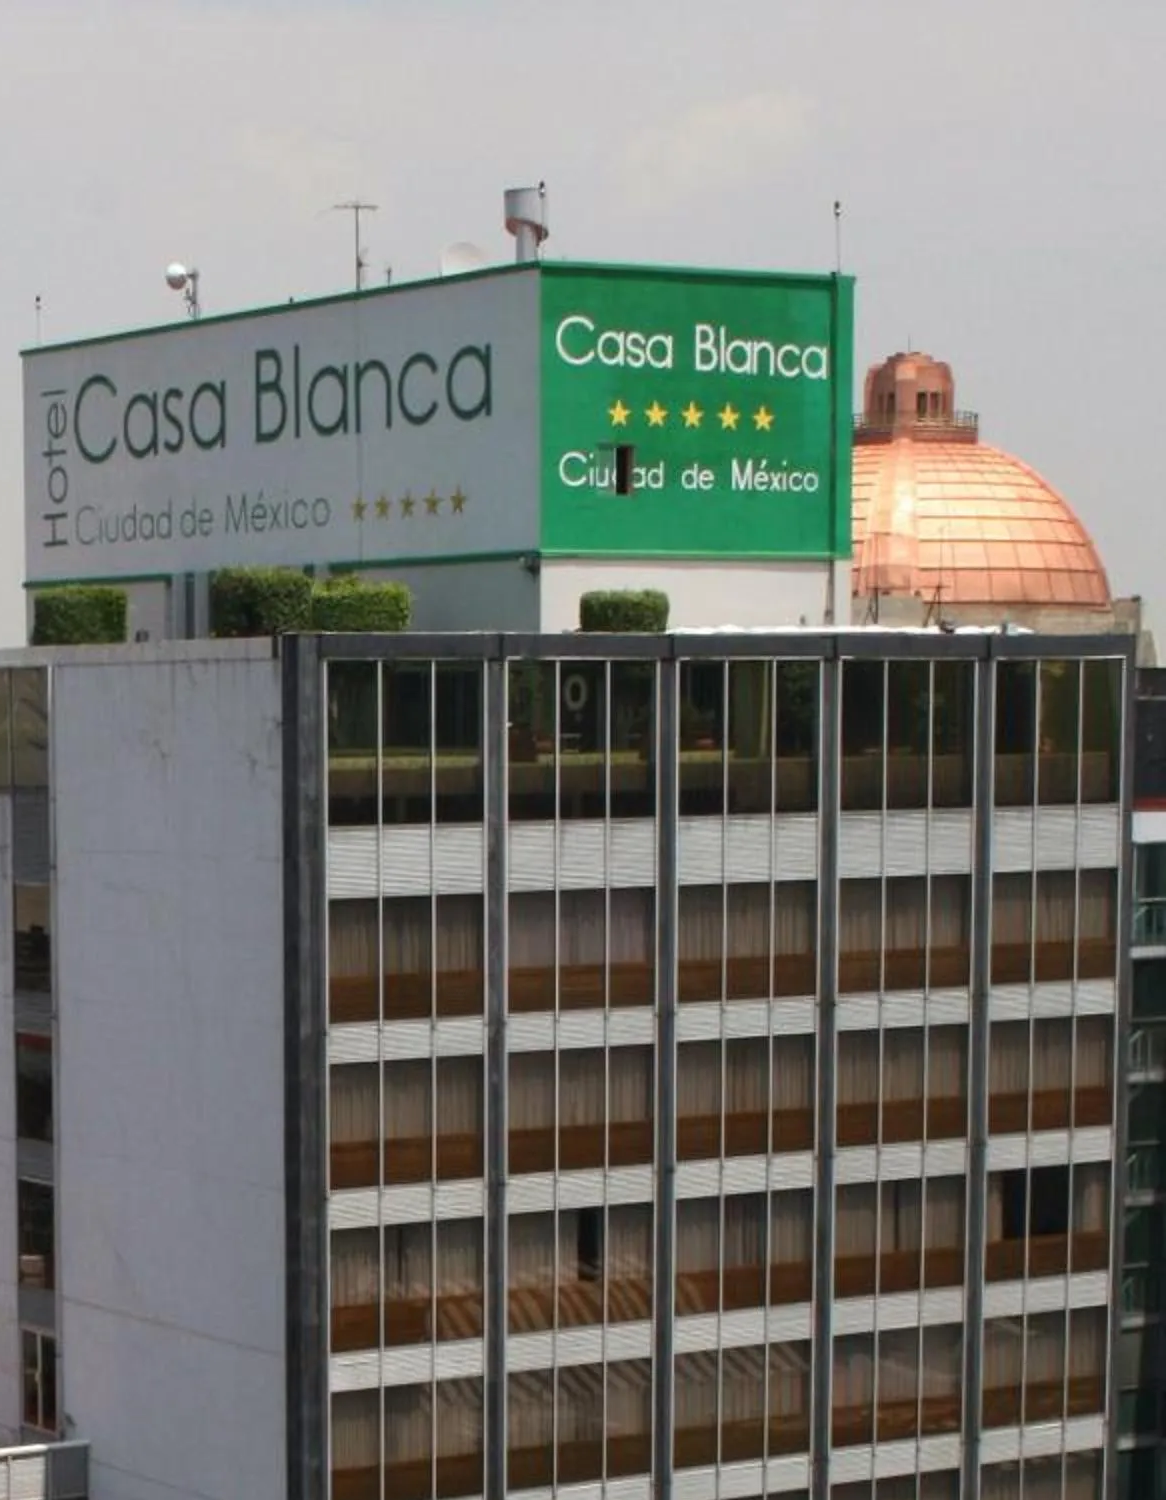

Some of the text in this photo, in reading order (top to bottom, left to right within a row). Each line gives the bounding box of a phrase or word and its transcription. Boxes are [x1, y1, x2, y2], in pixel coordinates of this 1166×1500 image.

[555, 315, 830, 380] Casa Blanca
[73, 342, 492, 465] Casa Blanca
[40, 389, 68, 547] Hotel
[681, 463, 715, 490] de
[731, 458, 819, 493] México
[75, 488, 332, 546] Ciudad de México
